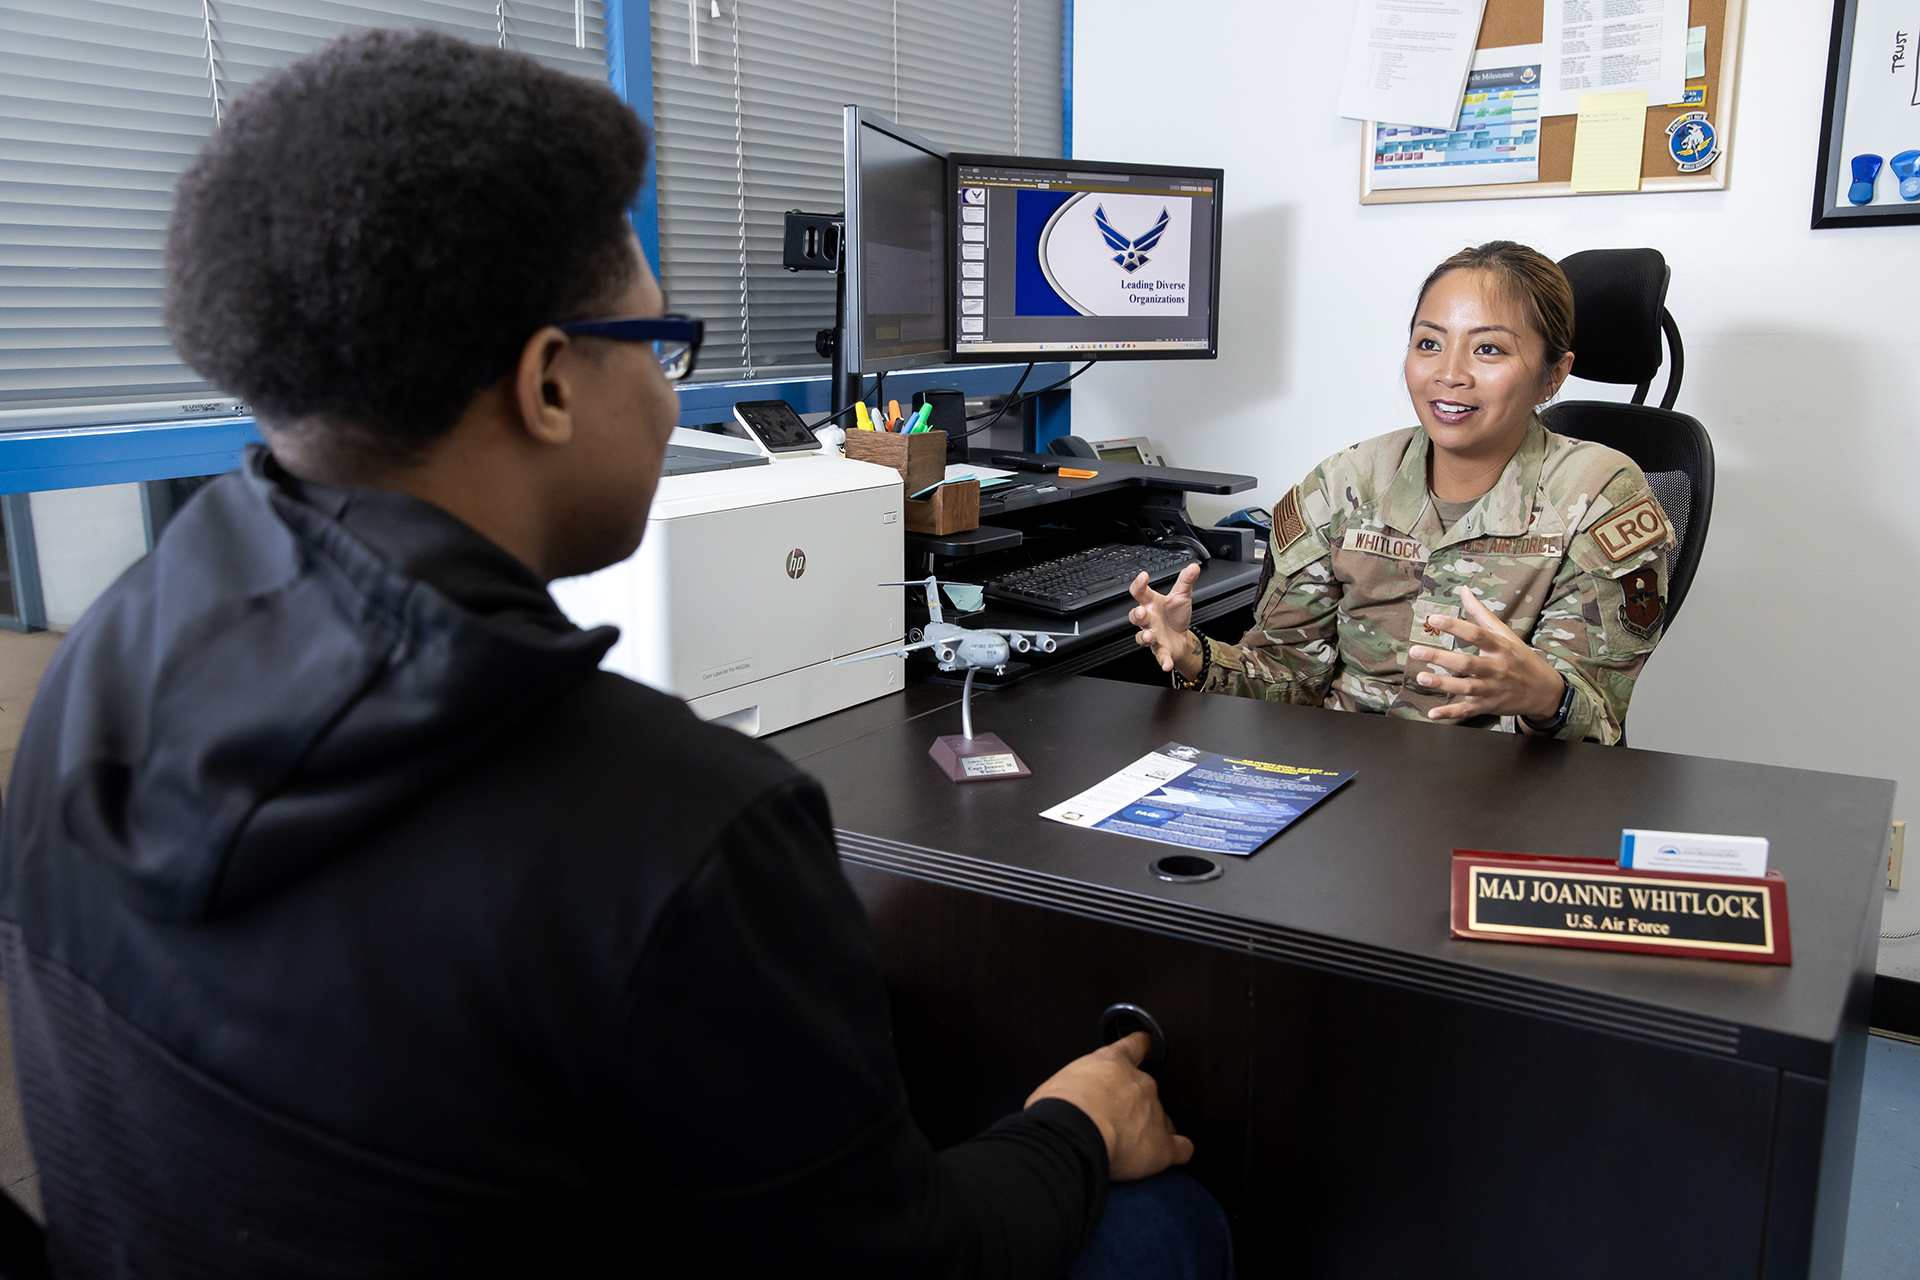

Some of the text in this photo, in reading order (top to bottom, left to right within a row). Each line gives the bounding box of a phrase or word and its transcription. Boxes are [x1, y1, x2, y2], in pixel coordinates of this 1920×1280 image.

[1892, 30, 1908, 74] TRUST
[1482, 71, 1514, 81] Milestones
[1121, 279, 1186, 292] Leading Diverse
[1129, 293, 1185, 305] Organizations
[1598, 508, 1658, 552] LRO
[1356, 532, 1422, 559] WHITLOCK
[1489, 537, 1512, 554] AIR
[1514, 536, 1556, 554] FORCE
[788, 548, 805, 580] hp
[888, 618, 893, 632] 1
[888, 671, 895, 685] 2
[1135, 810, 1160, 818] FAQs
[1478, 876, 1760, 920] MAJ JOANNE WHITLOCK
[1566, 913, 1670, 935] U.S. Air Force
